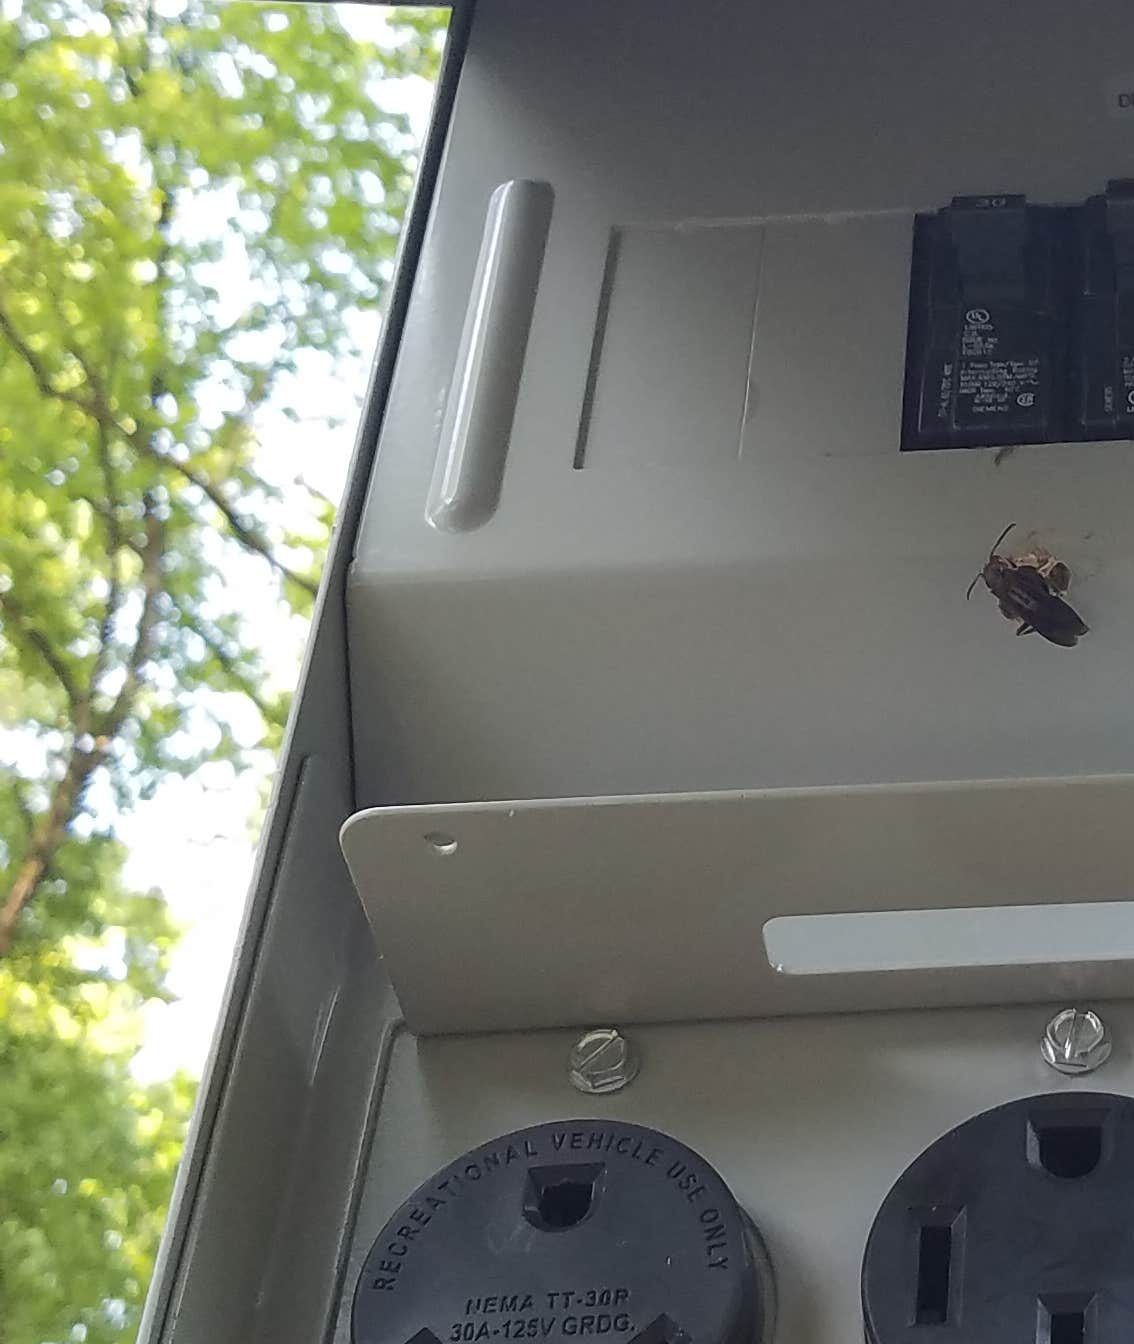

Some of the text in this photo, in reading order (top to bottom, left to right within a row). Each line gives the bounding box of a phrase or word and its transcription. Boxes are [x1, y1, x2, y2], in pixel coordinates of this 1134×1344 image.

[372, 1132, 729, 1292] RECREATIONAL VEHICLE USE ONLY
[465, 1288, 630, 1316] NEMA TT-30R
[449, 1318, 556, 1342] 30A-125V
